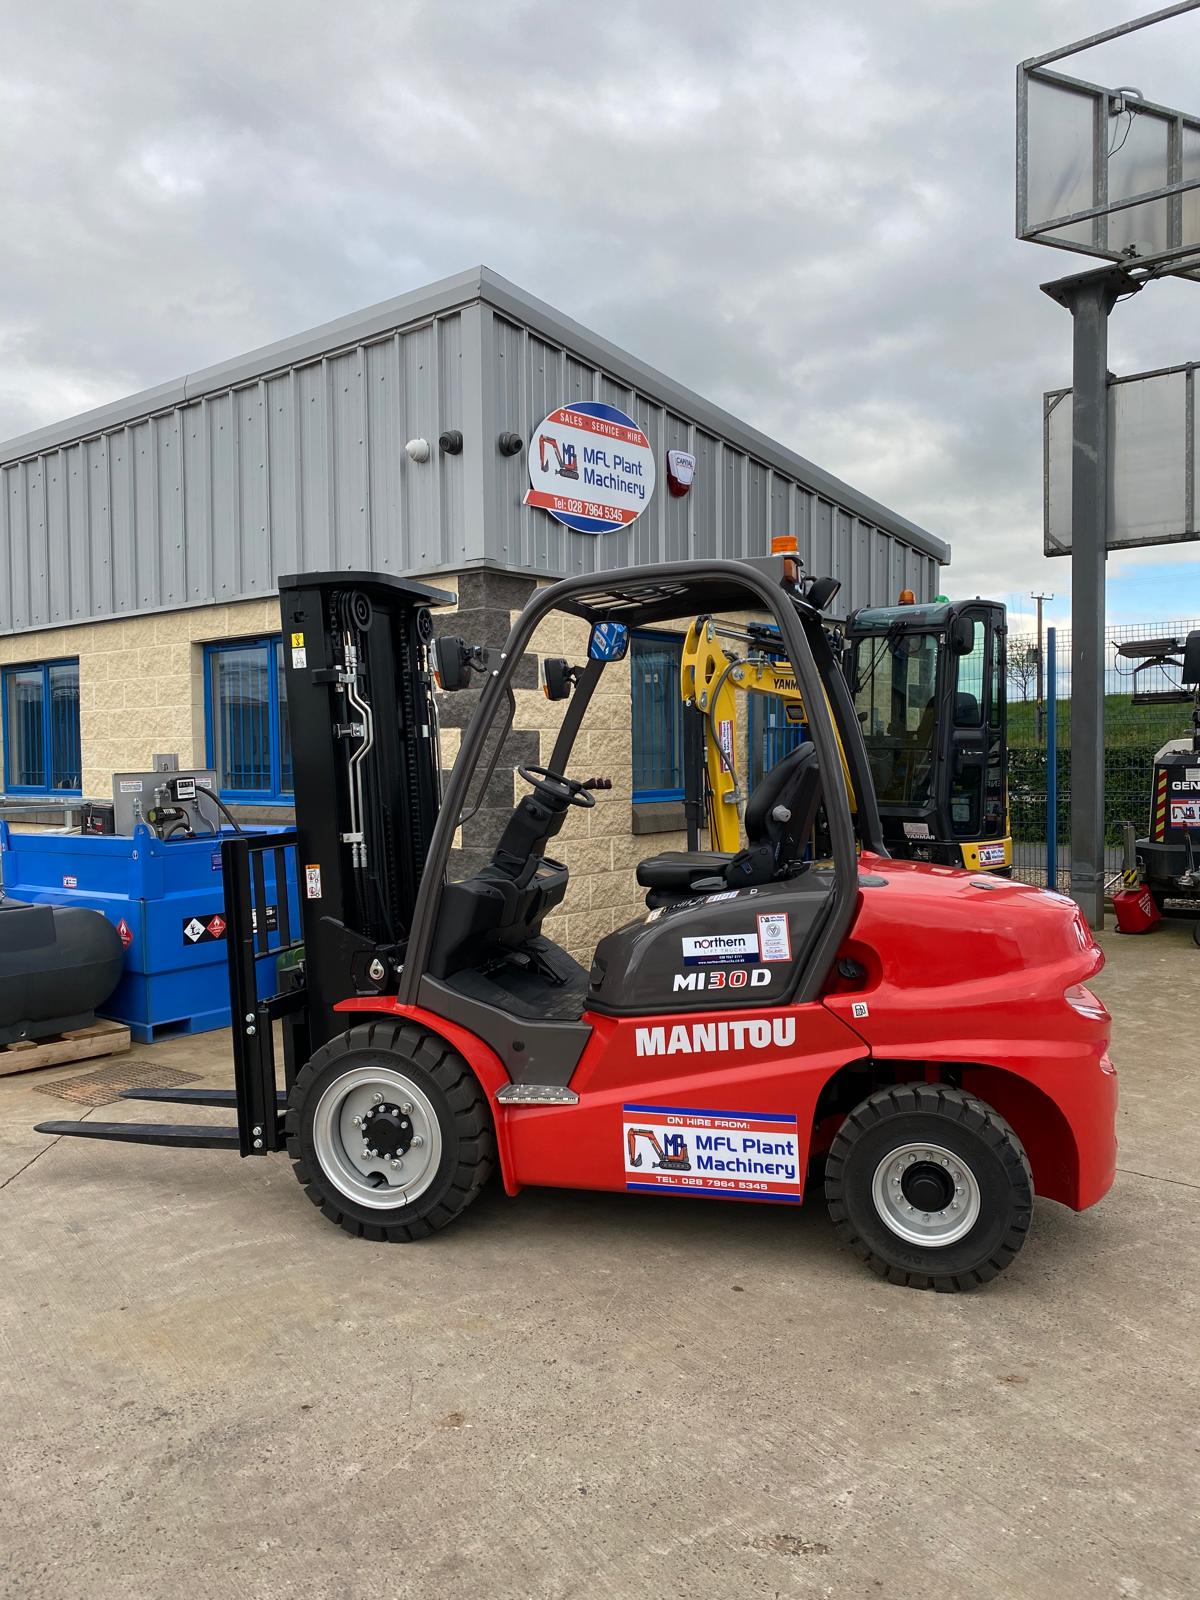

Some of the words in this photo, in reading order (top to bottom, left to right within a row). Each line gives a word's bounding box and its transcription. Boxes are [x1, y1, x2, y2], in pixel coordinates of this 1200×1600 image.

[560, 412, 583, 427] SALES
[591, 421, 620, 437] SERVICE
[627, 432, 642, 443] HIRE
[583, 447, 610, 468] MFL
[613, 454, 643, 476] Plant
[583, 467, 645, 499] Machinery
[553, 497, 567, 510] Tel:
[567, 499, 583, 513] 028
[584, 503, 604, 517] 7964
[604, 508, 623, 521] 5345
[773, 678, 800, 690] YANM
[694, 937, 746, 949] northern
[672, 968, 772, 991] MI30D
[635, 1017, 796, 1056] MANITOU
[667, 1116, 684, 1125] ON
[686, 1118, 712, 1127] HIRE
[714, 1120, 750, 1129] FROM:
[695, 1135, 737, 1153] MFL
[742, 1138, 794, 1156] Plant
[696, 1155, 796, 1179] Machinery
[656, 1175, 678, 1184] TEL:
[681, 1177, 703, 1185] 028
[706, 1179, 735, 1188] 7964
[738, 1181, 768, 1190] 5345
